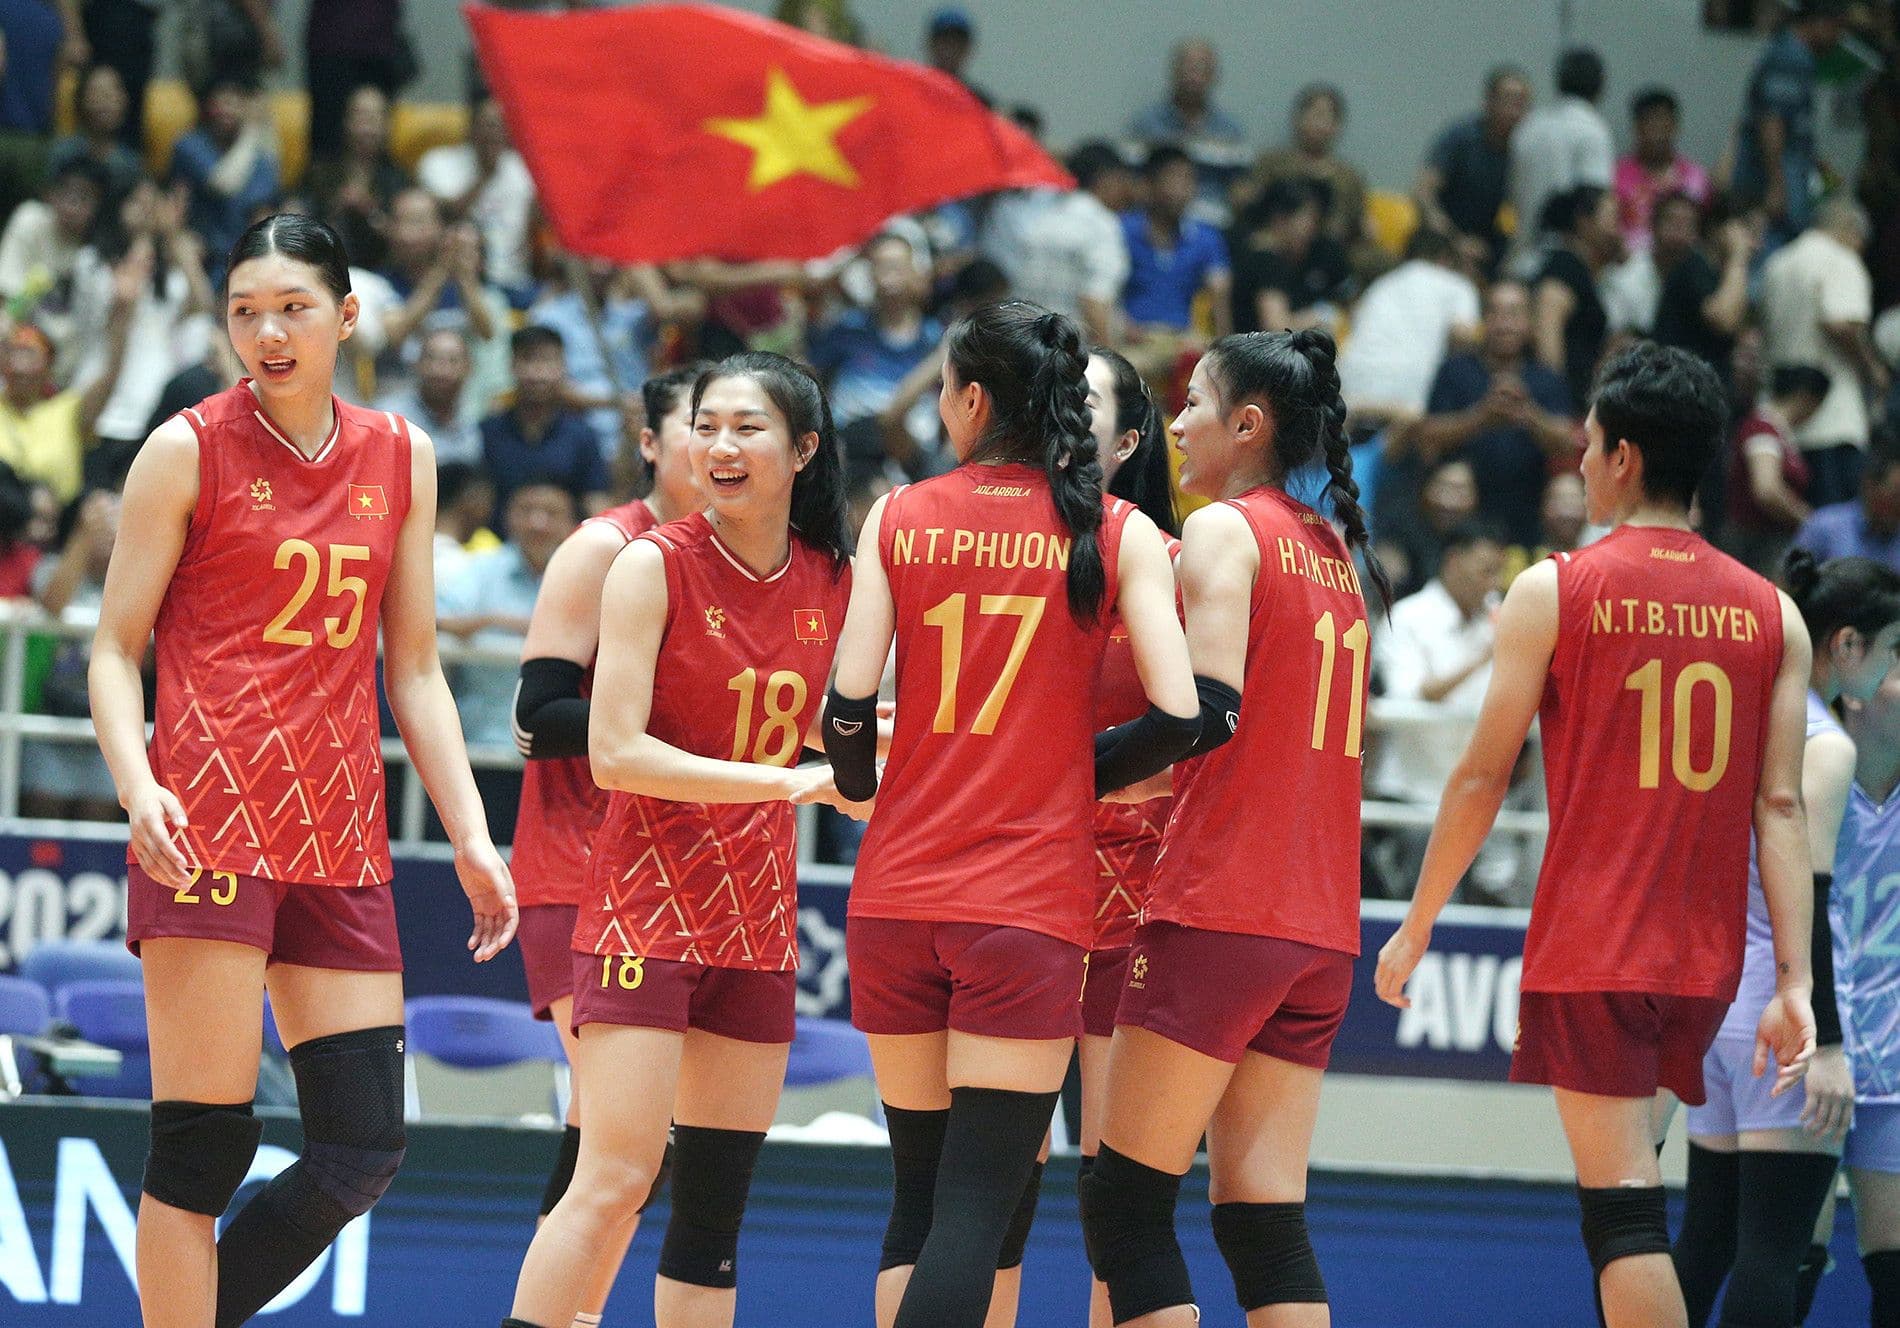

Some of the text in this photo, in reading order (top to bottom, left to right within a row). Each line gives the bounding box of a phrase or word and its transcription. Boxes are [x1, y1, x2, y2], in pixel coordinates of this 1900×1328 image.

[971, 485, 1032, 498] JOCARBOLA
[262, 539, 370, 649] 25
[727, 667, 808, 766] 18
[923, 593, 1046, 736] 17
[1310, 610, 1369, 758] 11
[1624, 658, 1733, 793] 10
[174, 866, 239, 906] 25
[601, 955, 645, 990] 18
